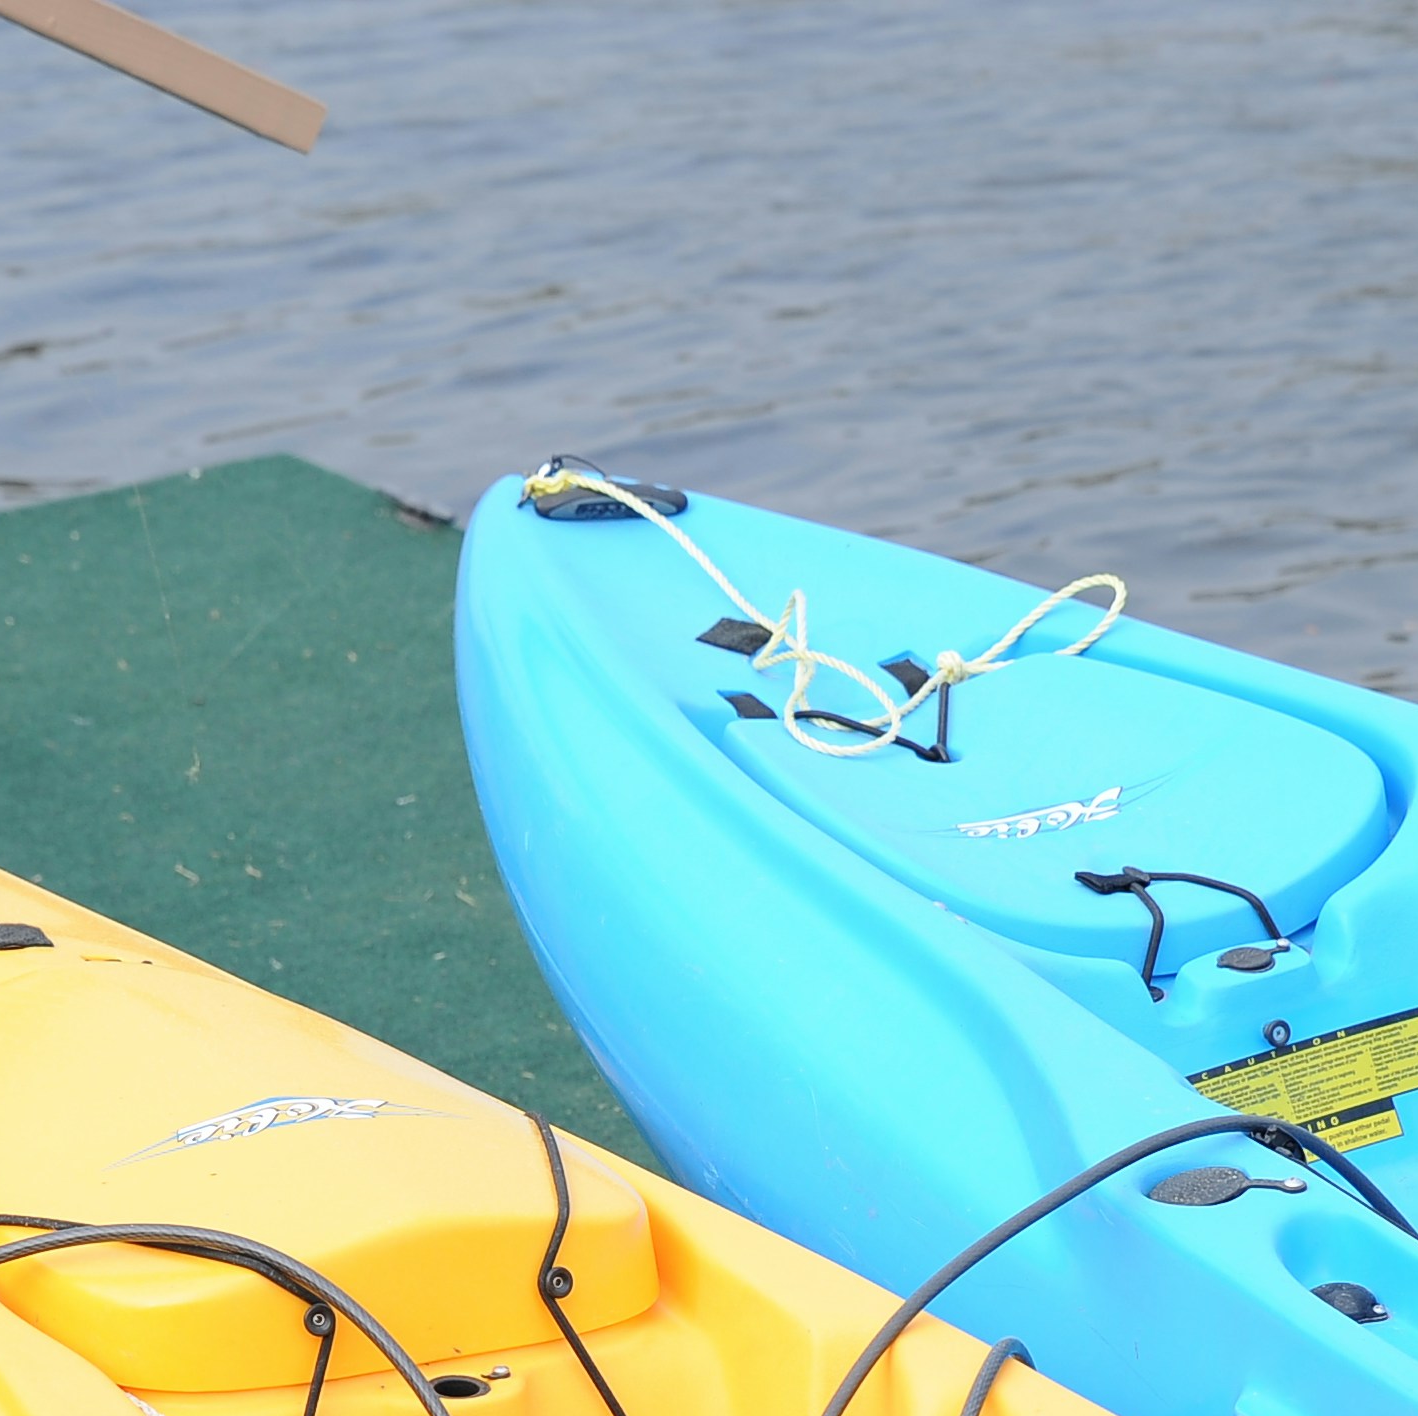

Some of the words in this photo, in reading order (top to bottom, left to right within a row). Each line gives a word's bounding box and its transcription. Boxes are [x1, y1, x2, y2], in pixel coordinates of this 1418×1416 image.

[956, 786, 1123, 839] Hobie
[1201, 1030, 1346, 1080] CAUTION
[177, 1097, 389, 1145] Hobie
